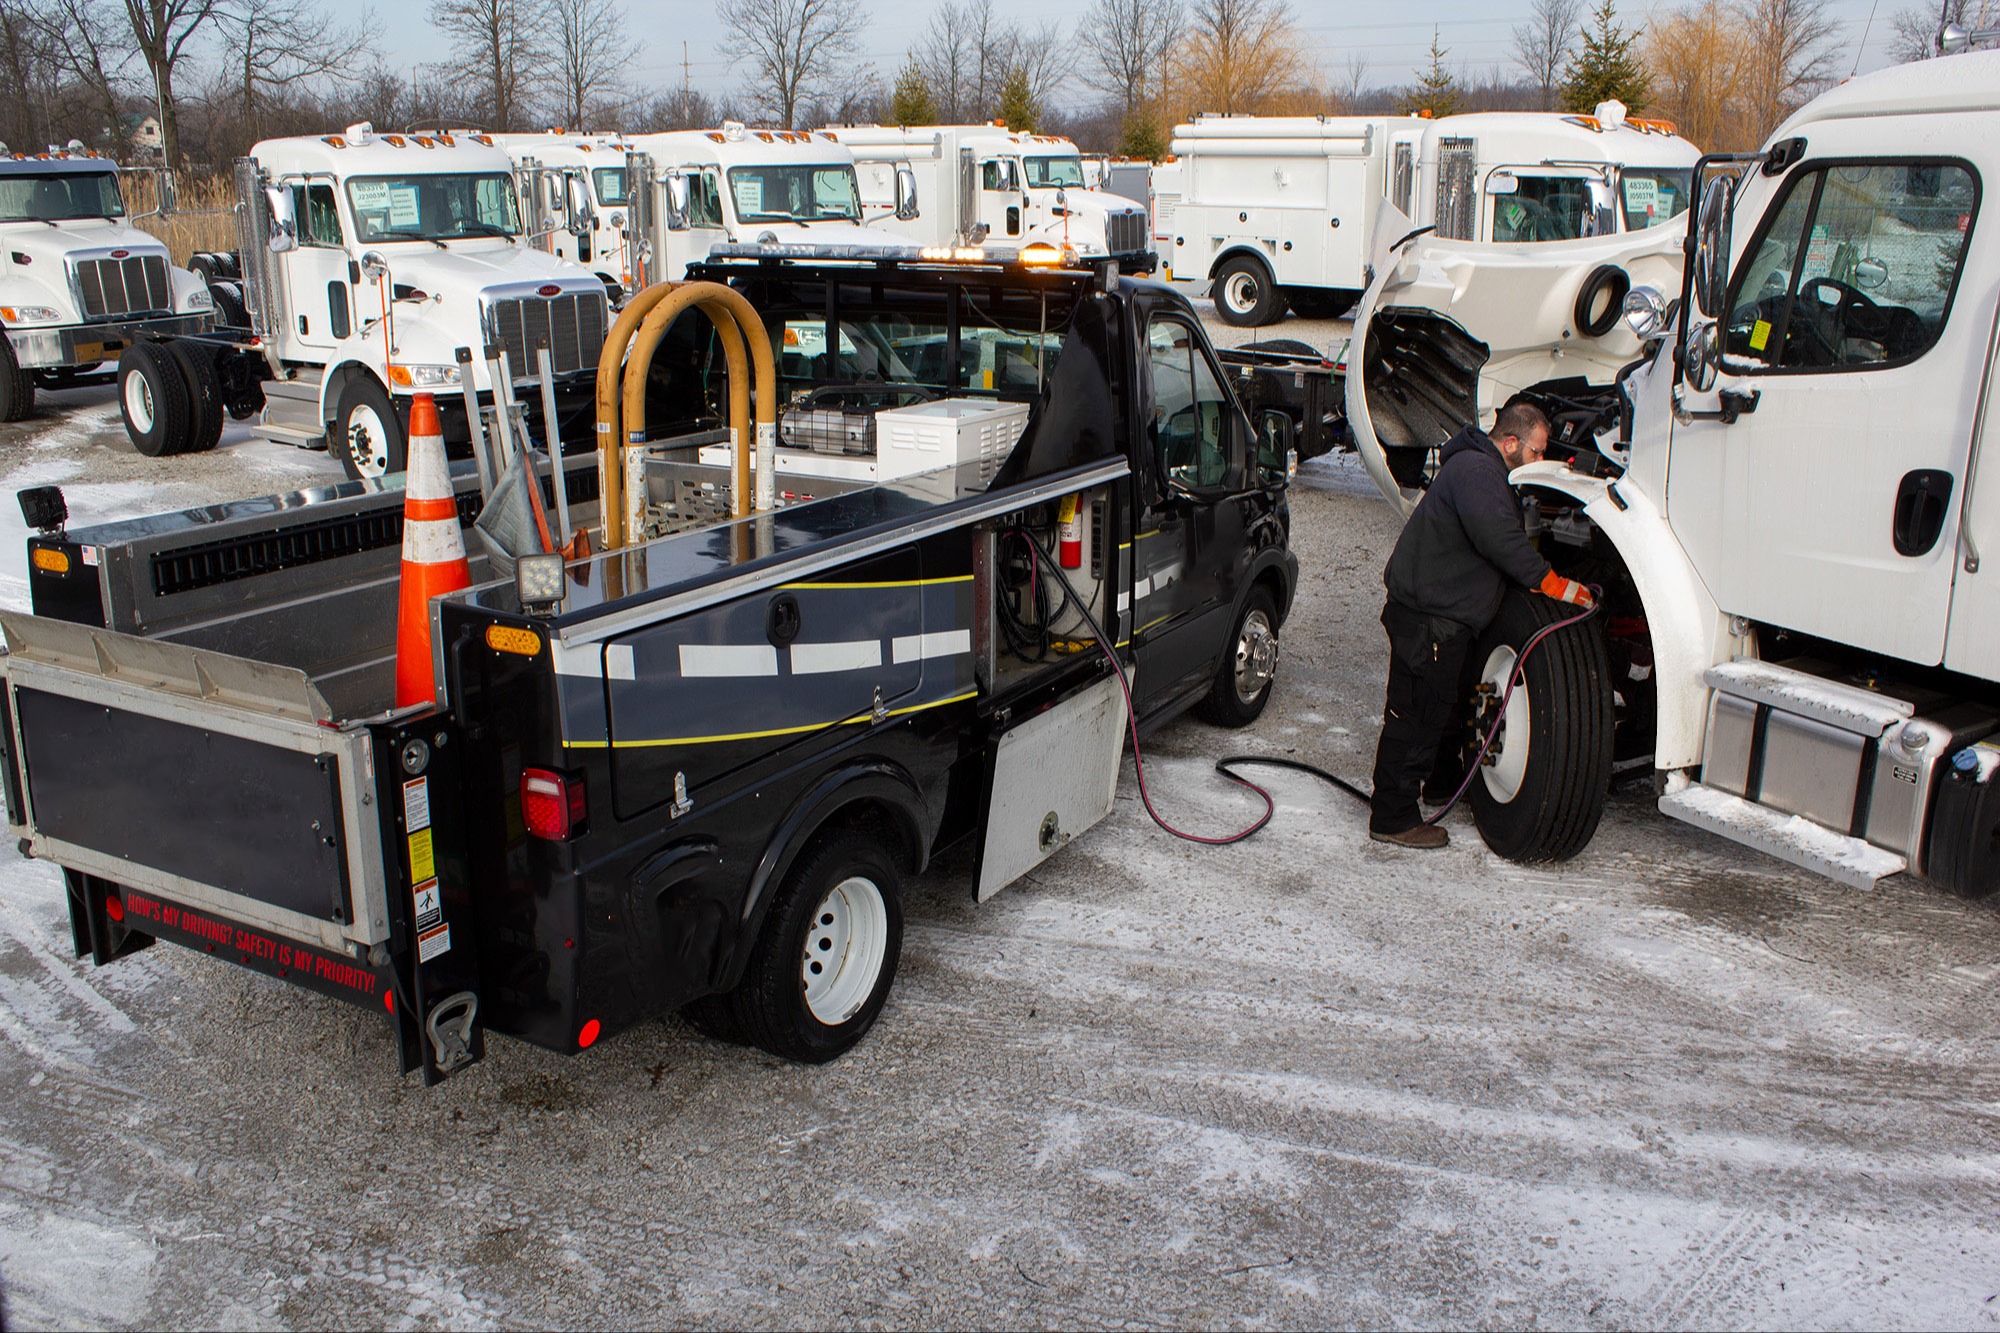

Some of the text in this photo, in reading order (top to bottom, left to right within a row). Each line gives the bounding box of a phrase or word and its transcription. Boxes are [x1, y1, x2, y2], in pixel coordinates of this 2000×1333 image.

[1629, 181, 1653, 190] 483365
[127, 893, 376, 995] HOW'S MY DRIVING? SAFETY IS MY PRIORITY!
